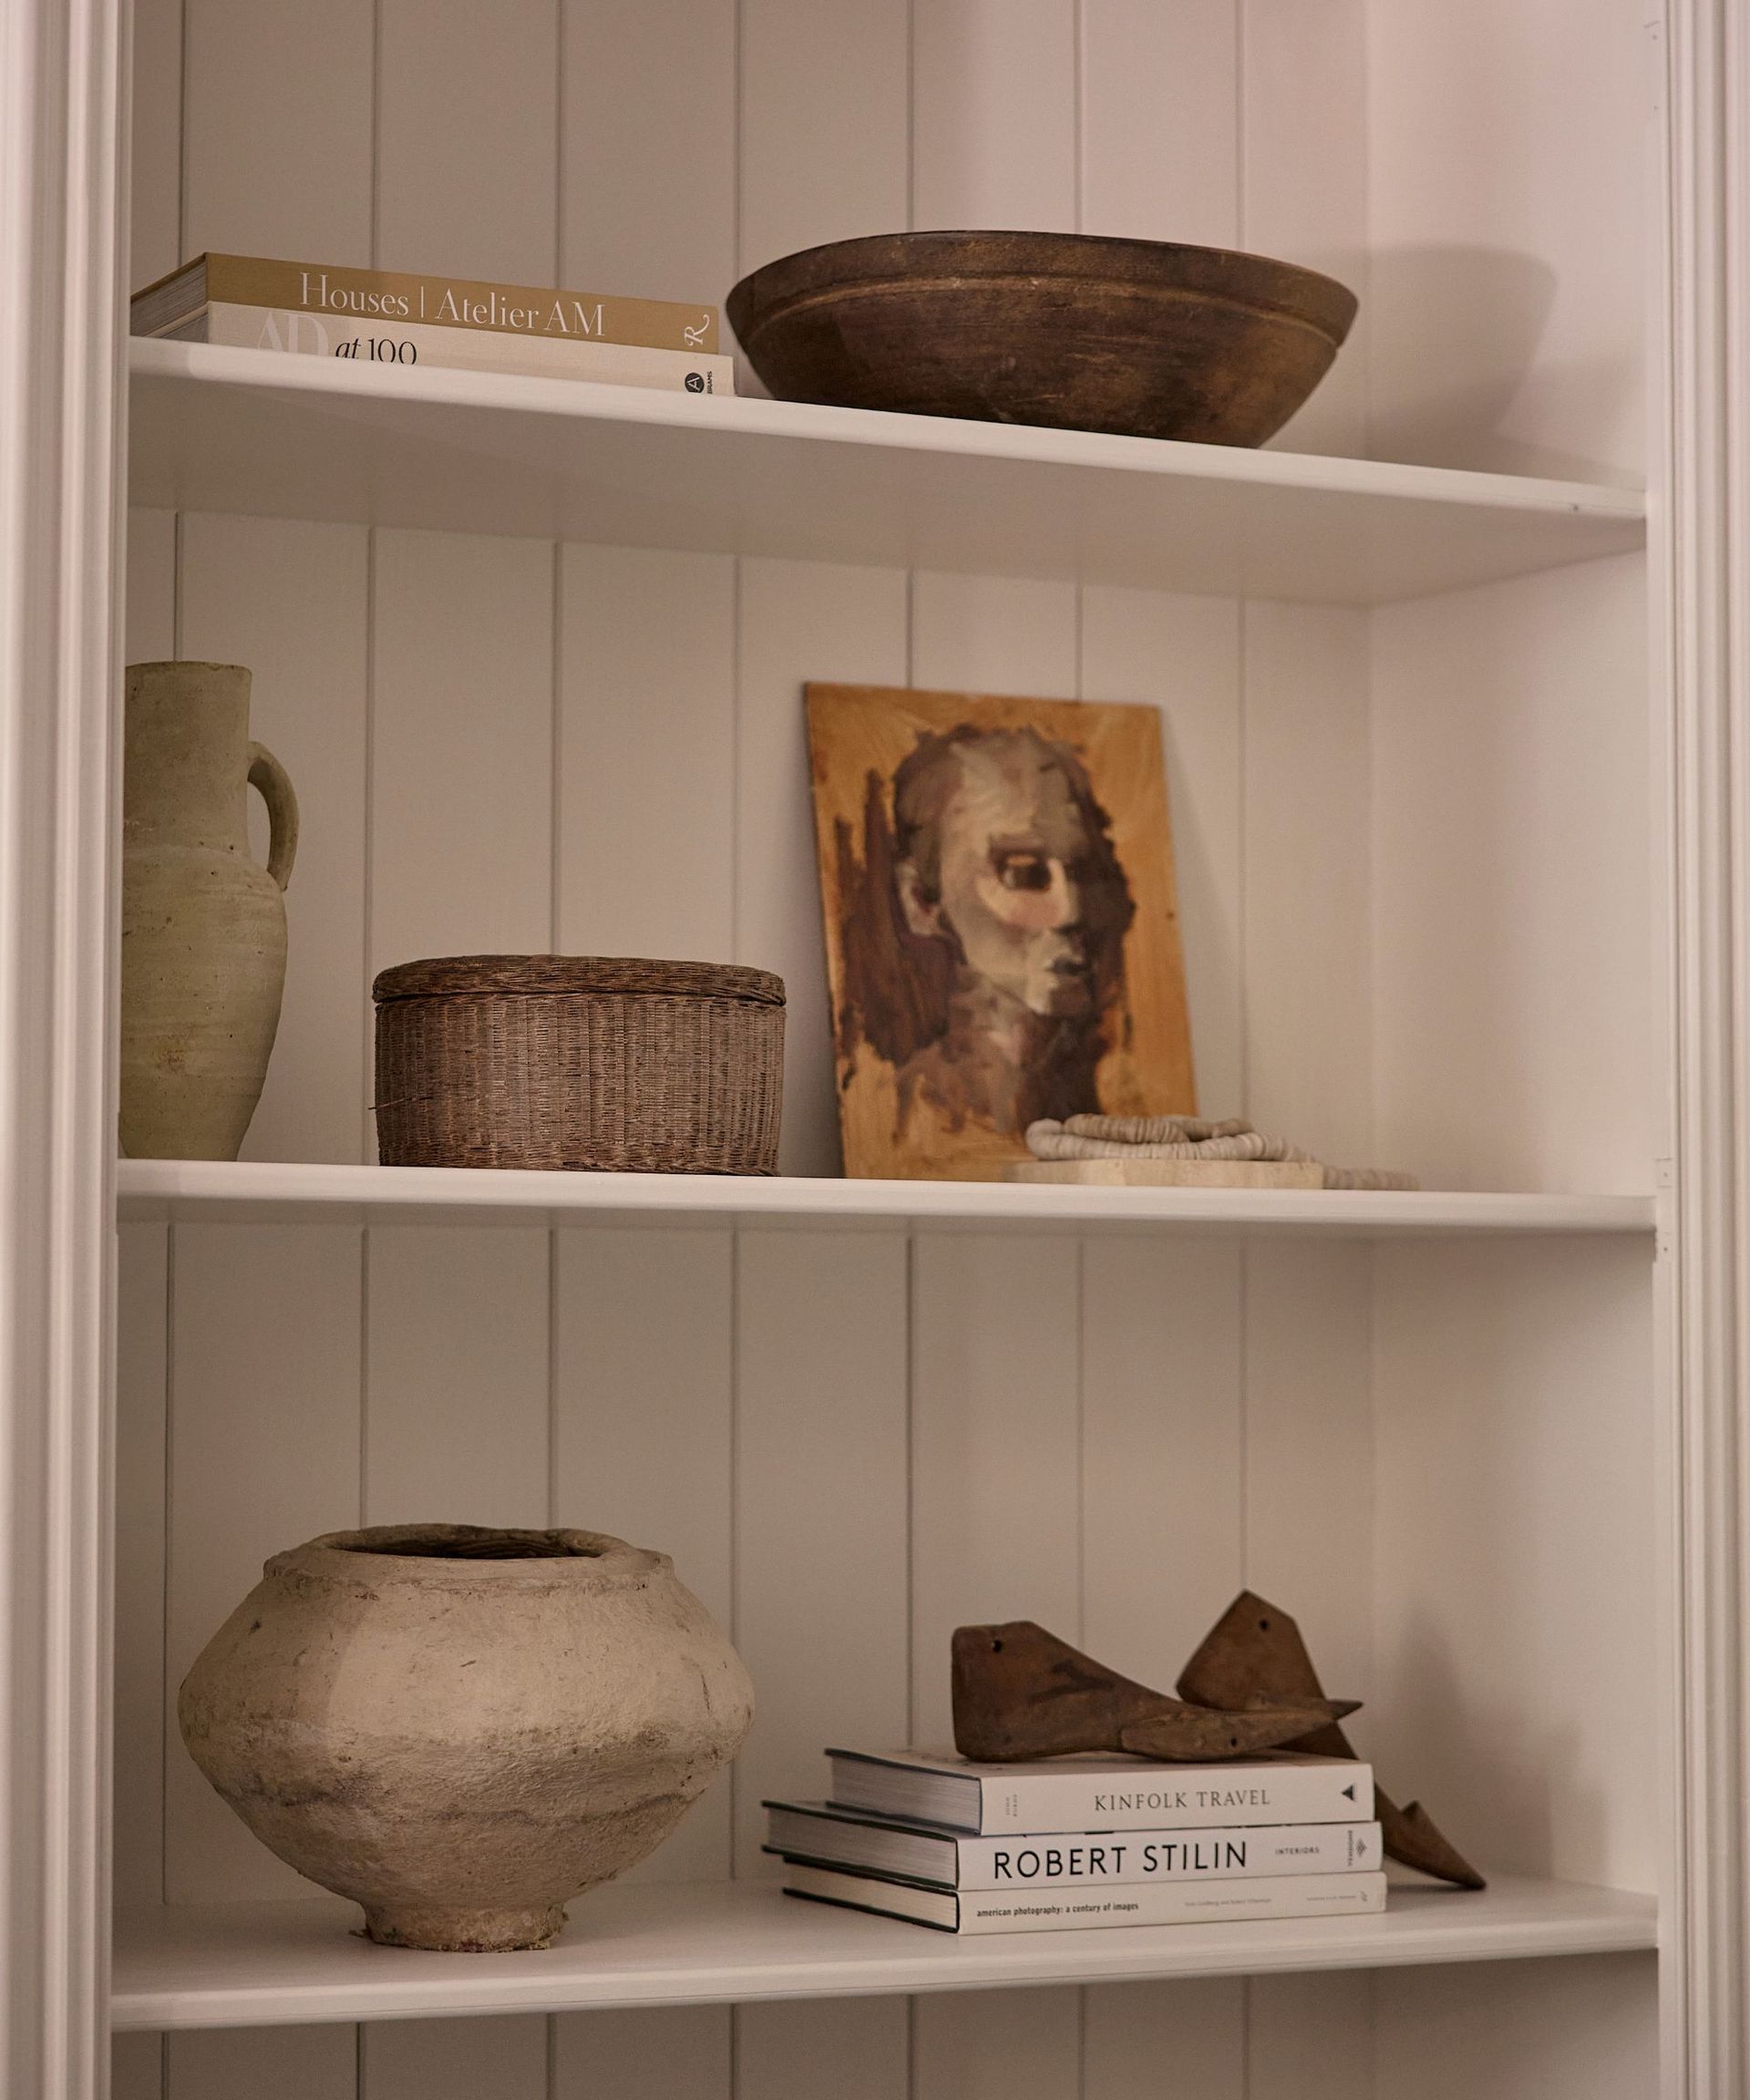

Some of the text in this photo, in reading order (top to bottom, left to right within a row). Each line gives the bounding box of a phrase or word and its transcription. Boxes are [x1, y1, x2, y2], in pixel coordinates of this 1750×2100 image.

[299, 272, 606, 336] Houses Atelier AM
[256, 313, 417, 365] AD at 100
[1095, 1789, 1271, 1812] KINFOLK TRAVEL
[994, 1841, 1246, 1879] ROBERT STILIN
[1275, 1847, 1320, 1855] INTERIORS
[977, 1909, 1012, 1917] american
[1014, 1905, 1064, 1917] photography:
[1073, 1903, 1100, 1913] century
[1103, 1902, 1111, 1911] of
[1113, 1901, 1138, 1911] images
